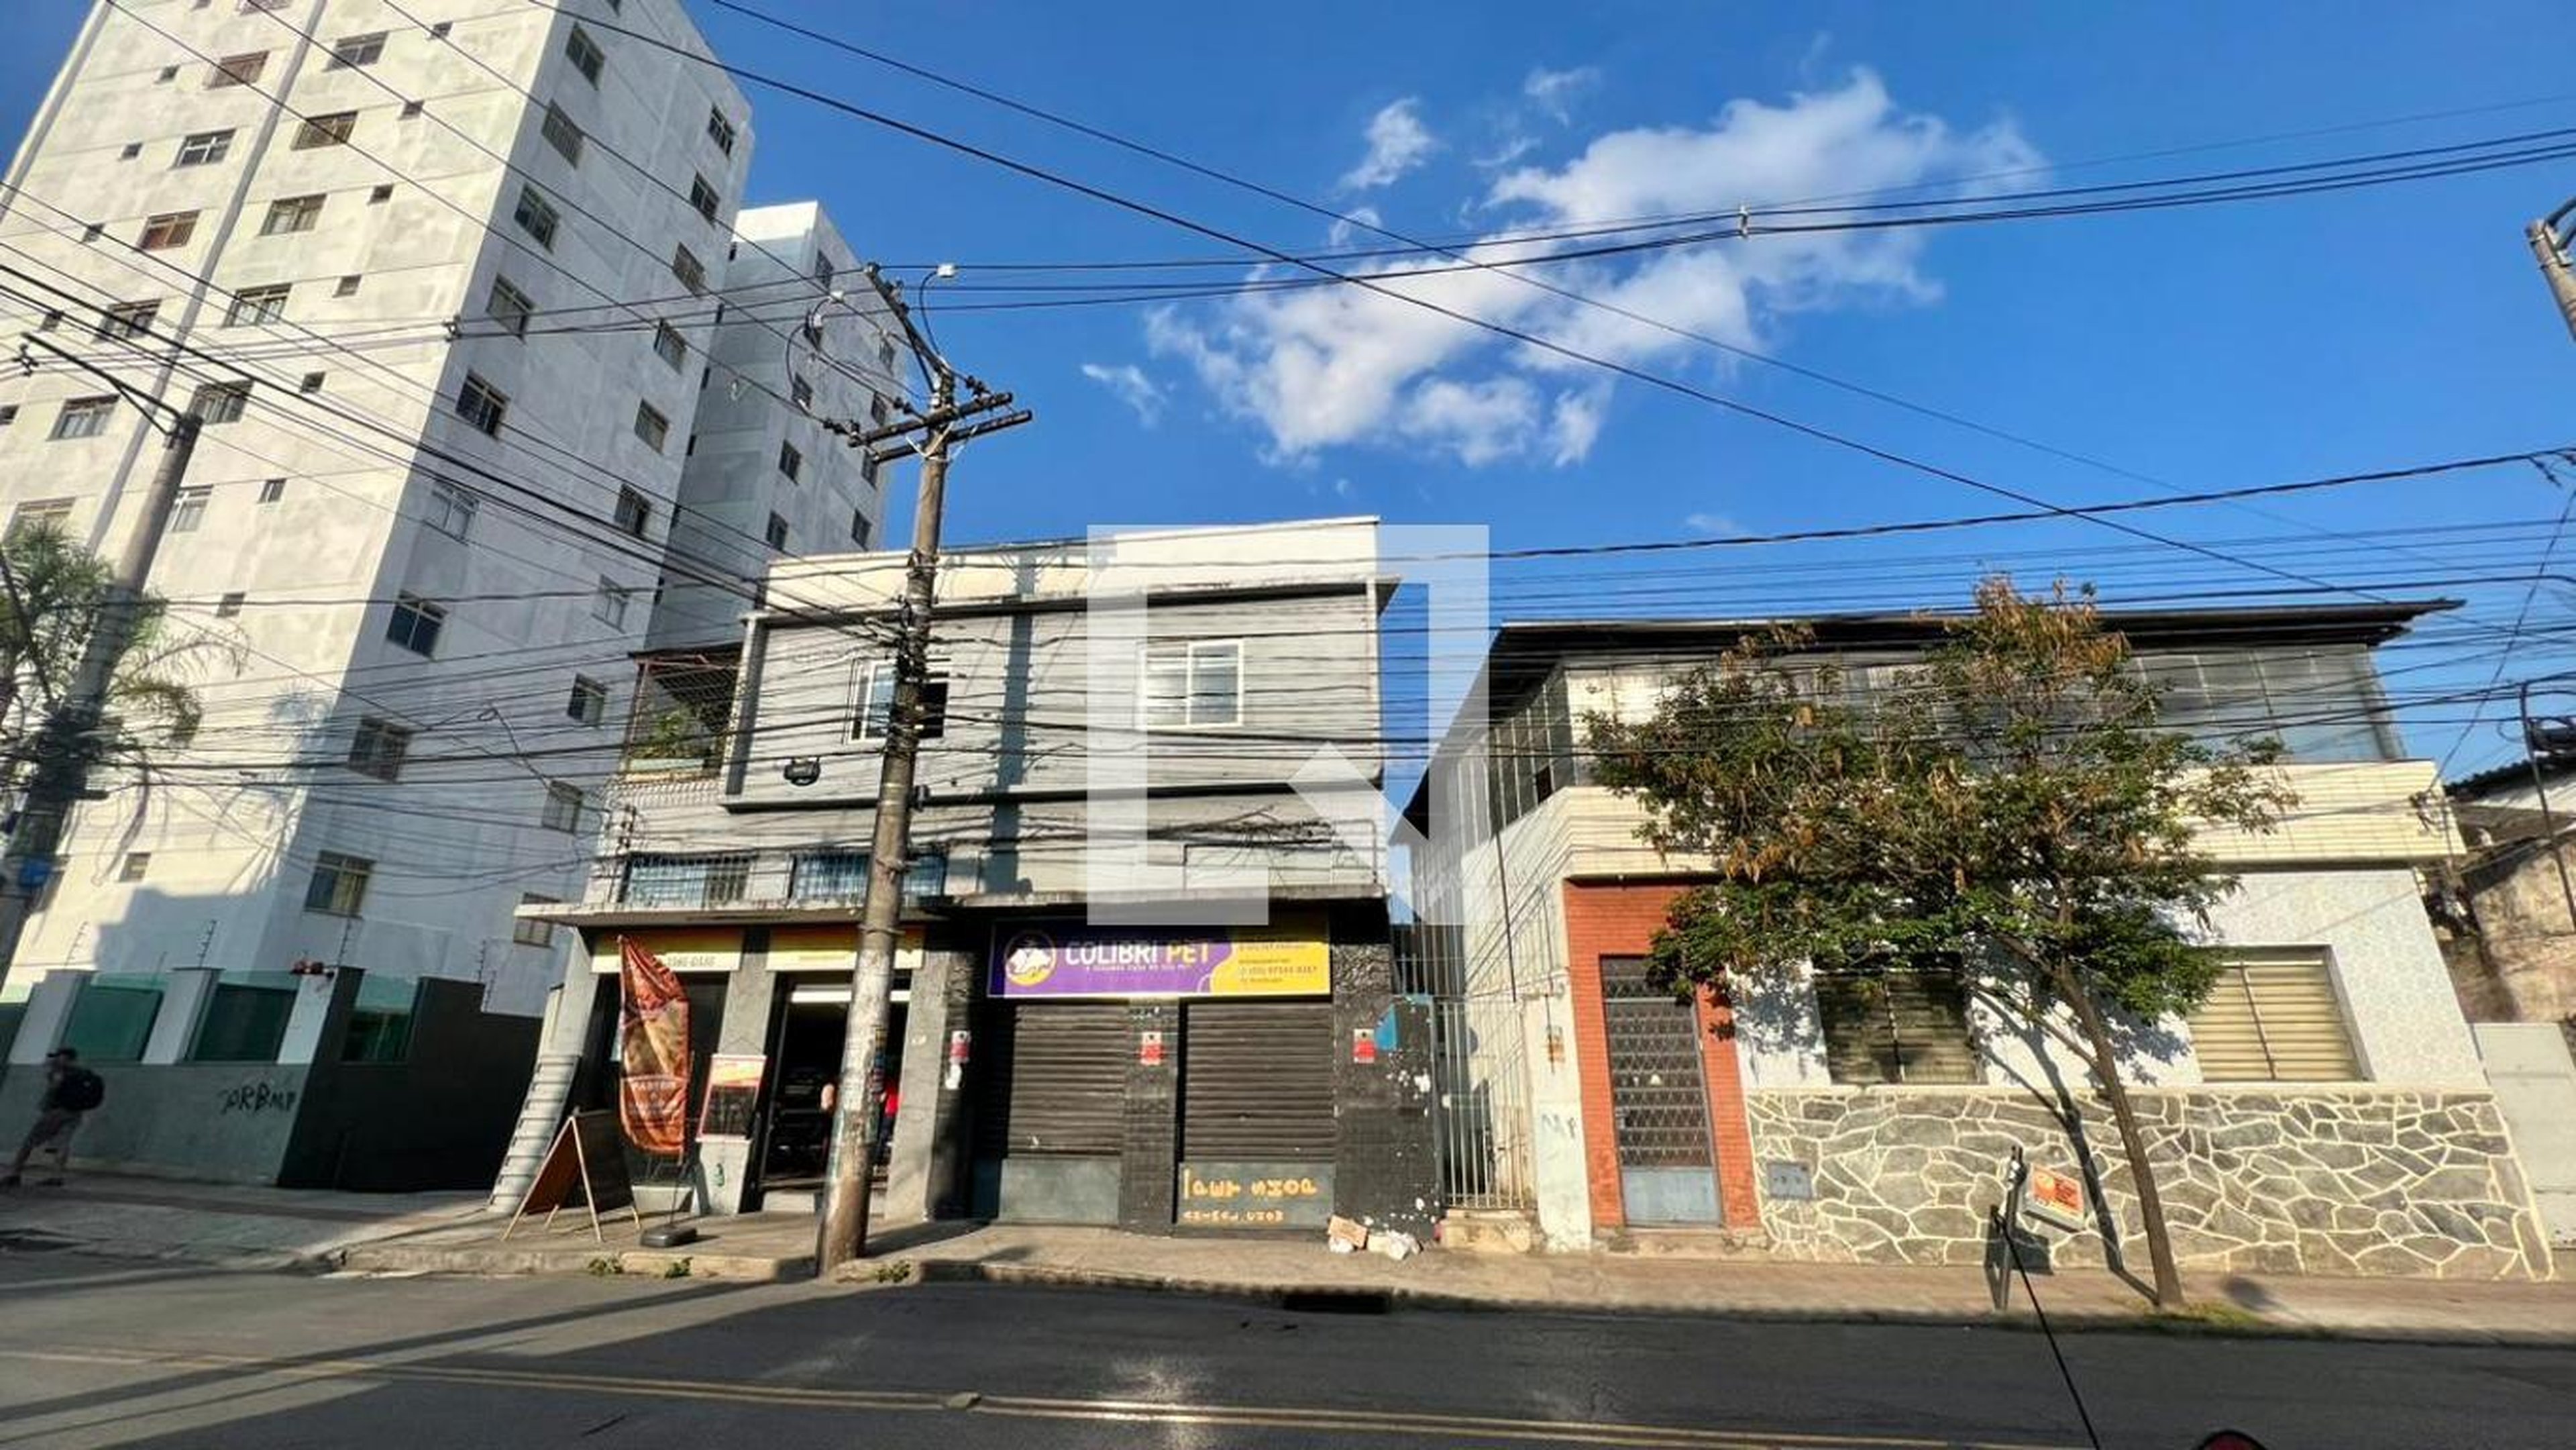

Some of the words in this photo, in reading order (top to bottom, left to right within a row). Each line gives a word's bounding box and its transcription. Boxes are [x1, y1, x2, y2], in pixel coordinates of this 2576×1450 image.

[1065, 941, 1157, 965] COLIBRI
[1166, 939, 1211, 964] PET
[1250, 1178, 1317, 1197] SHOP
